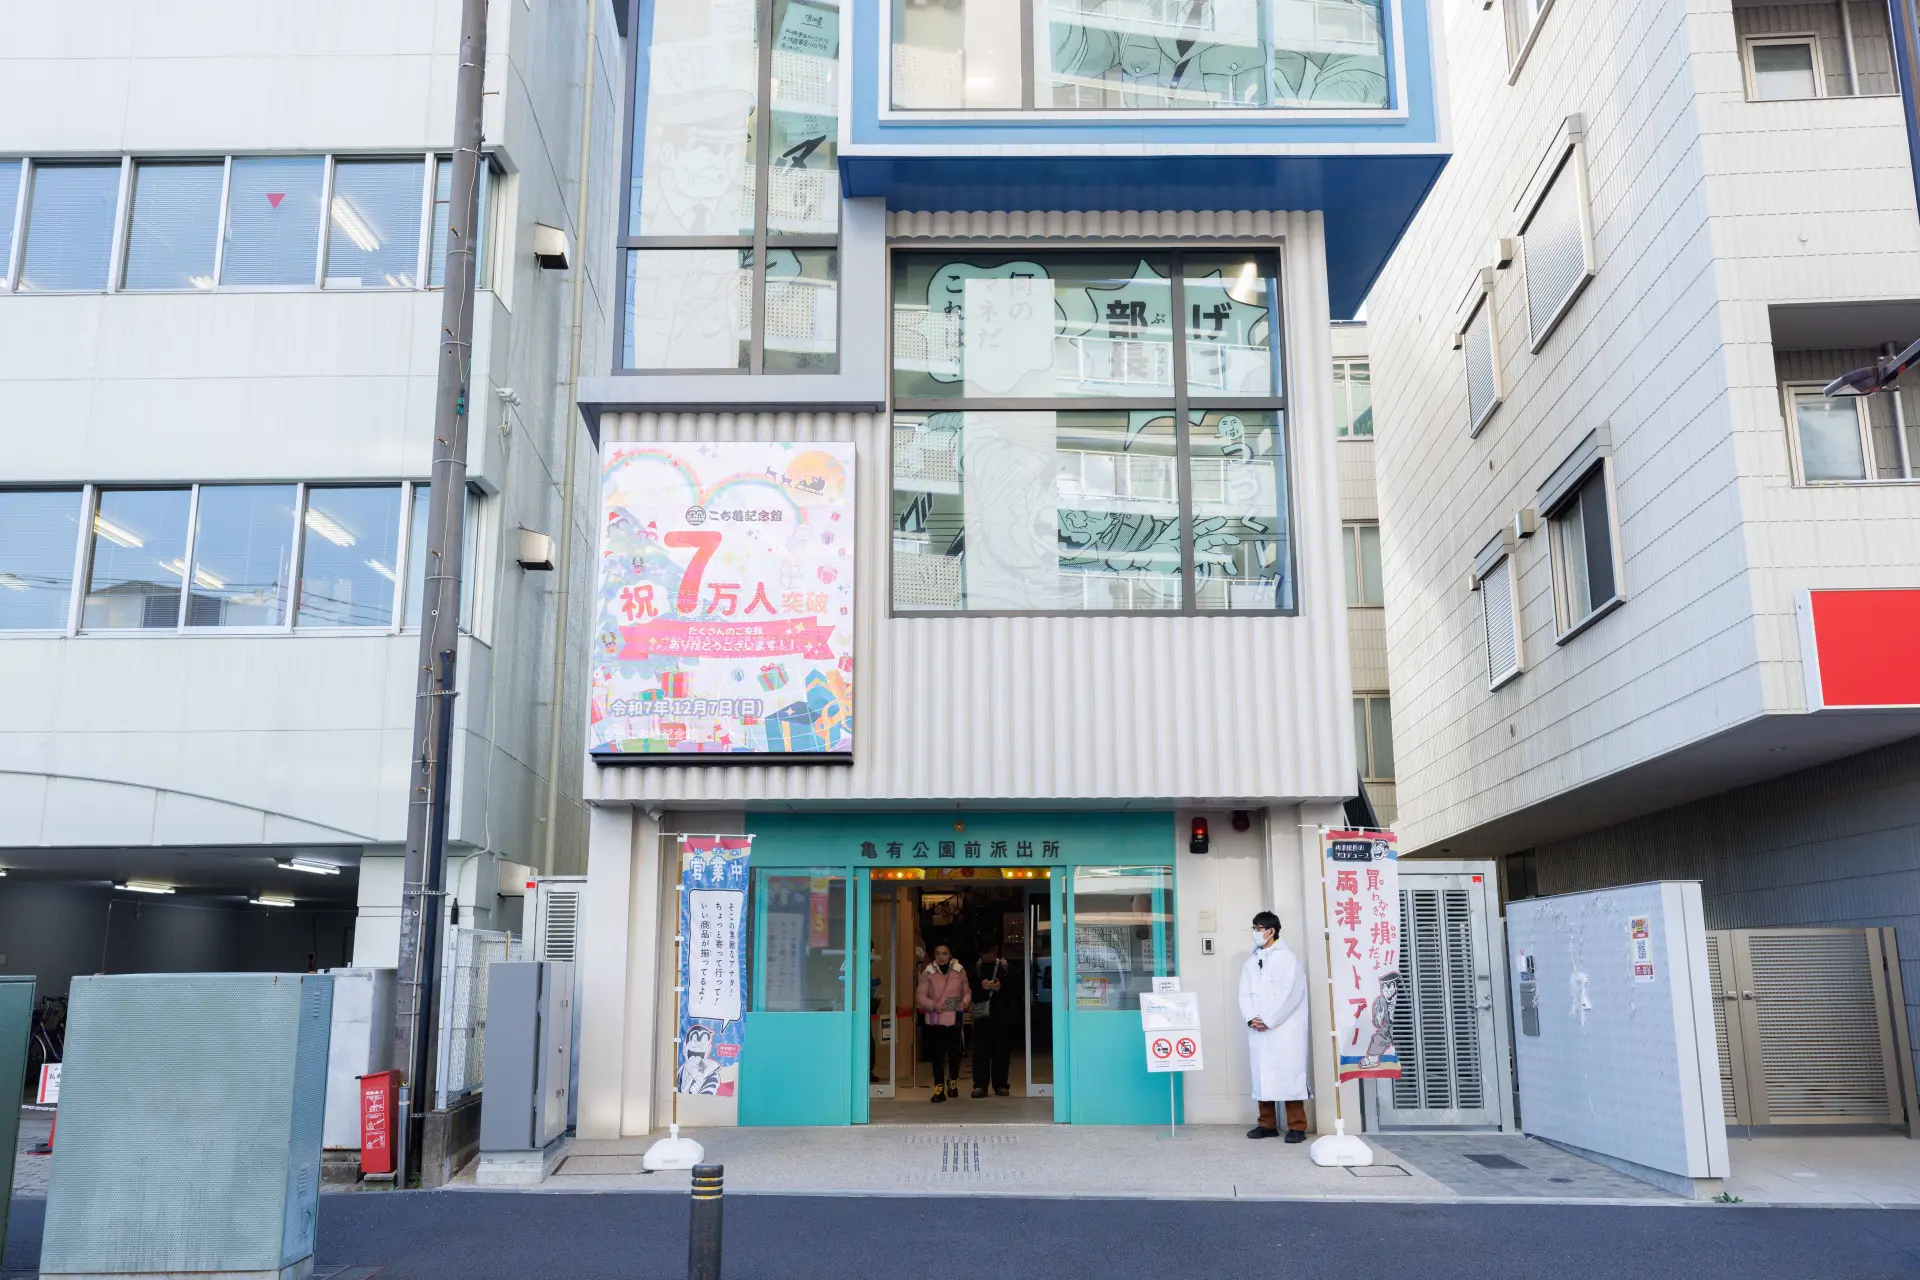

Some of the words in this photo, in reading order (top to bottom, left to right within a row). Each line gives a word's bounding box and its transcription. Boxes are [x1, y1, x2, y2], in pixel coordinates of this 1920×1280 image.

[708, 509, 783, 522] こち亀記念館
[619, 584, 659, 621] 祝
[611, 699, 669, 717] 令和7年
[860, 840, 1061, 859] 亀有公園前派出所
[690, 855, 743, 883] 営業中
[1334, 870, 1368, 1046] 両津ストアー
